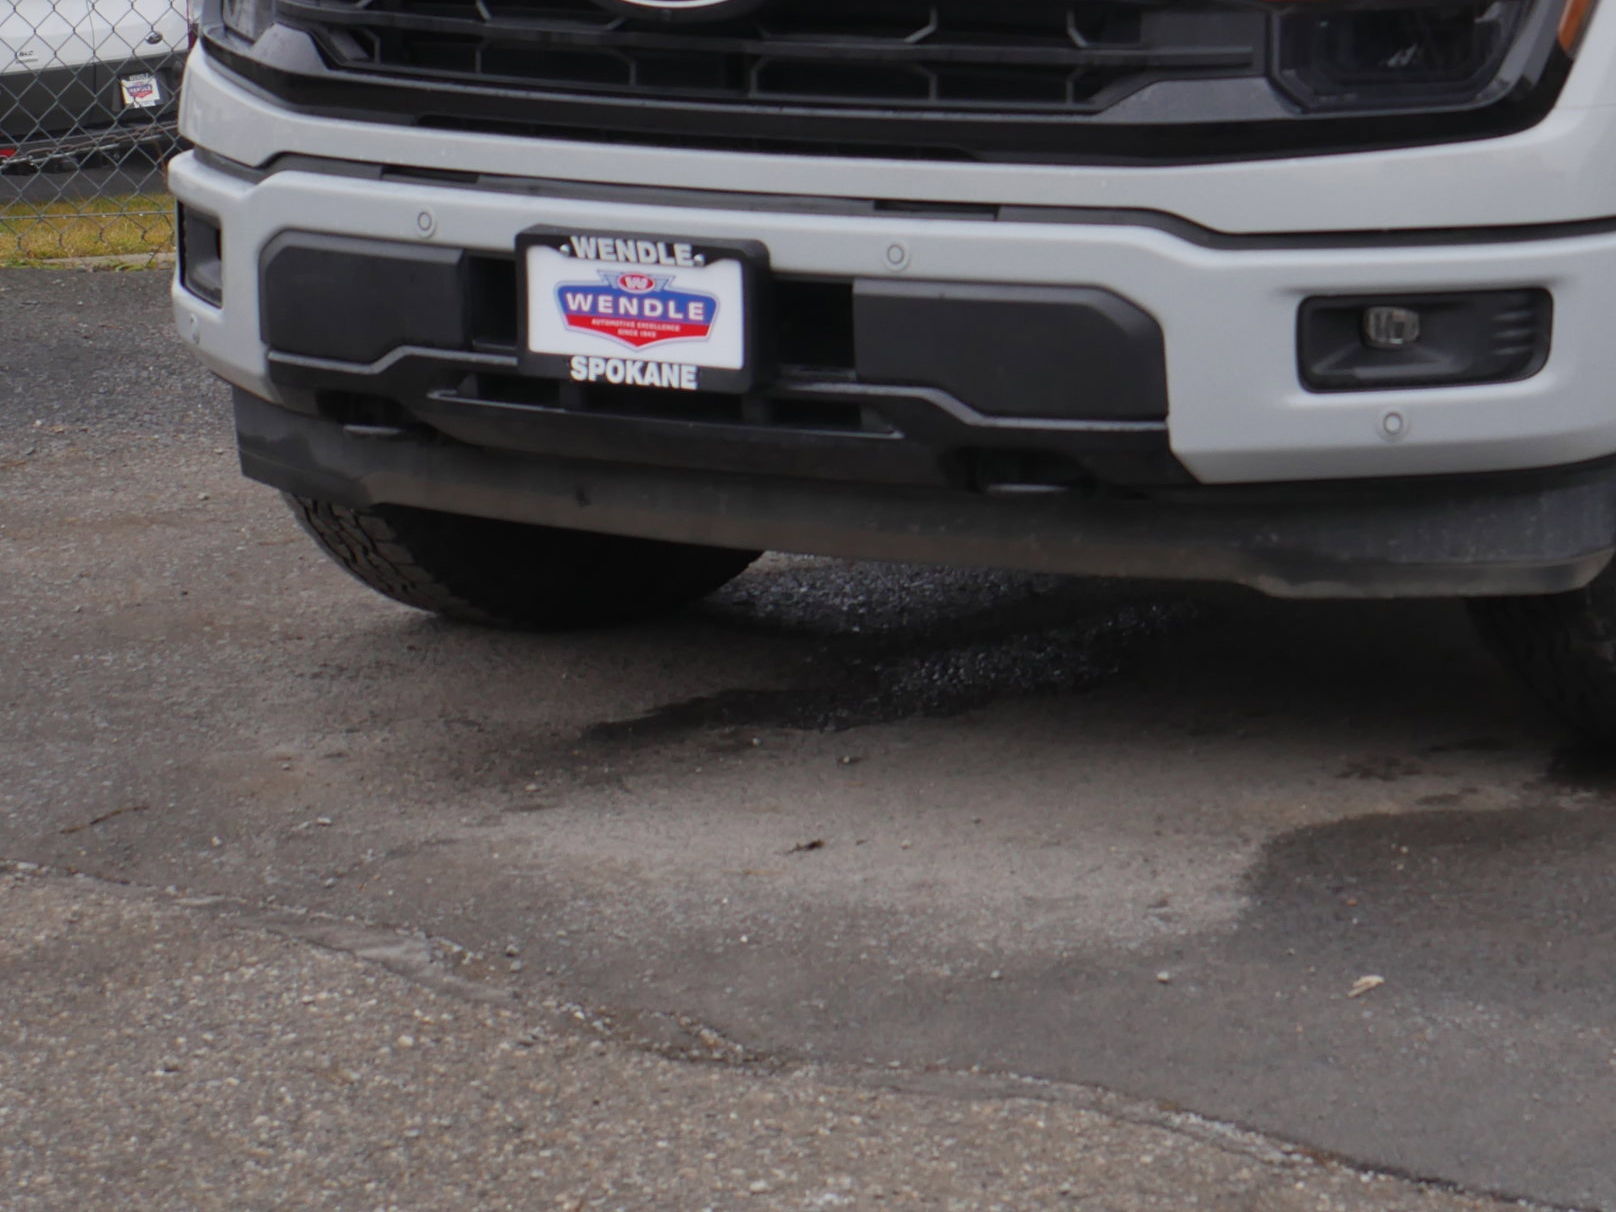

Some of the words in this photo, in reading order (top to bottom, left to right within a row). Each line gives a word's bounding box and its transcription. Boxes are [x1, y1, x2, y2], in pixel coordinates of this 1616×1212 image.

[570, 236, 694, 266] WENDLE
[566, 292, 705, 320] WENDLE
[570, 355, 698, 390] SPOKANE
